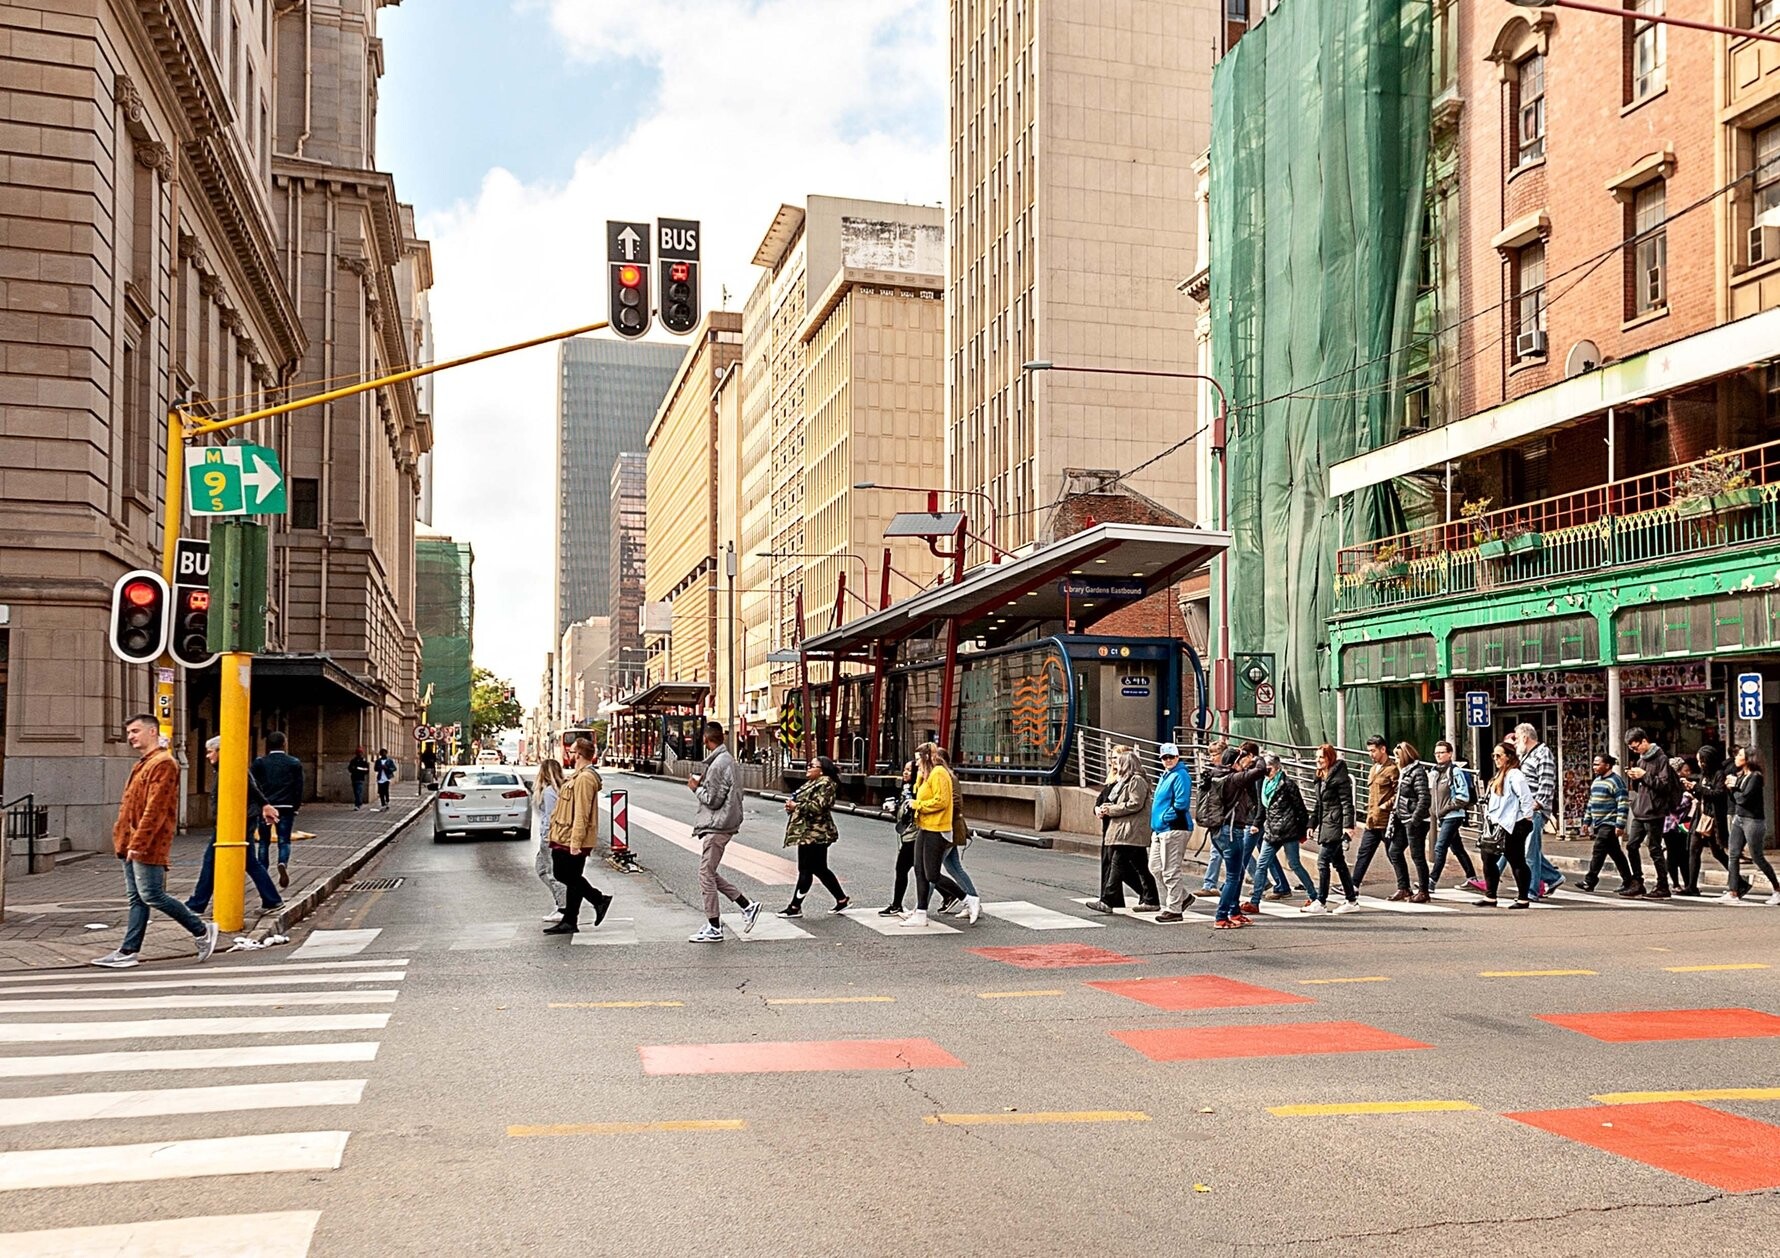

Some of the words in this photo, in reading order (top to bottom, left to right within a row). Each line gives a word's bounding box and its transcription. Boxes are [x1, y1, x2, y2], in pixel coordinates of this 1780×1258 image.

[661, 227, 696, 251] BUS
[207, 451, 221, 463] M
[204, 472, 226, 496] 9
[211, 498, 224, 511] S
[180, 551, 210, 575] BU
[1063, 585, 1084, 595] Lbrary
[1085, 586, 1109, 594] Gardens
[1111, 587, 1142, 595] Eastbound
[1745, 696, 1757, 716] R
[1473, 708, 1483, 723] R
